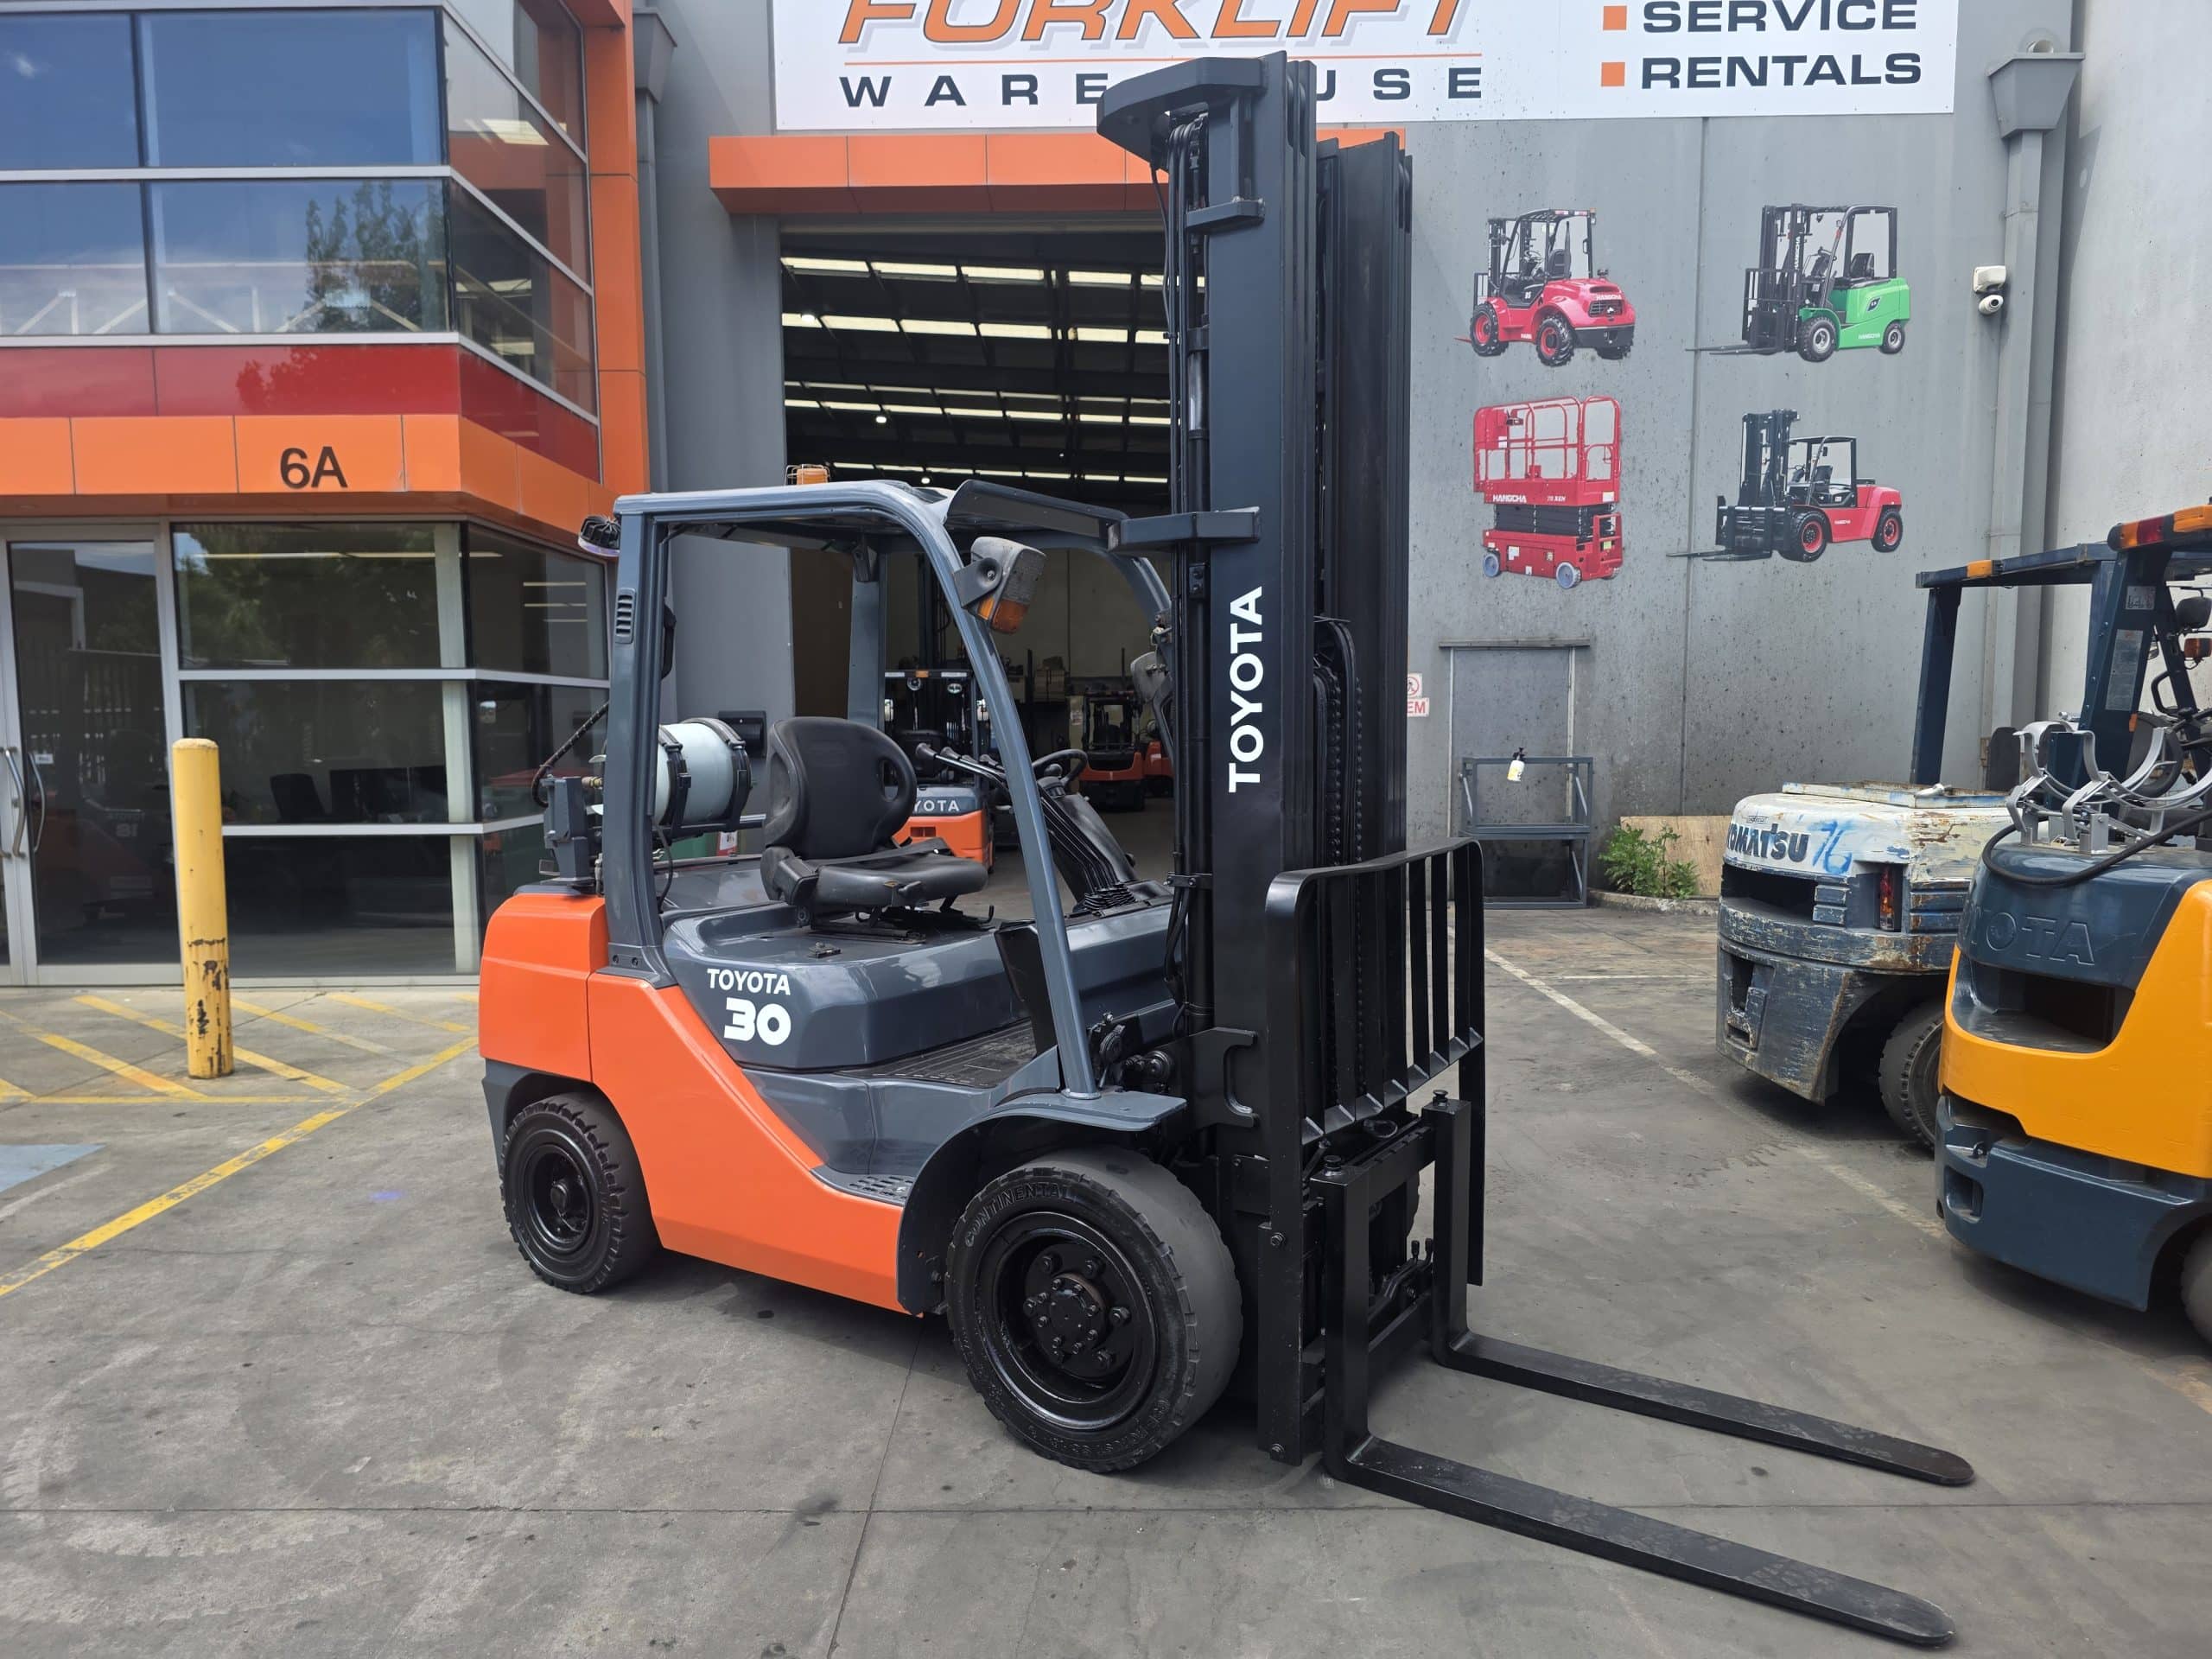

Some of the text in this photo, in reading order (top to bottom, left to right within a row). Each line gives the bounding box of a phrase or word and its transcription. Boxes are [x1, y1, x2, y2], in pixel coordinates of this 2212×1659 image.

[1643, 0, 1917, 33] SERVICE
[839, 67, 1482, 107] WAREUSE
[1642, 53, 1921, 89] RENTALS
[280, 446, 348, 490] 6A
[1492, 494, 1527, 503] HANGCHA
[1229, 586, 1264, 793] TOYOTA
[914, 799, 959, 812] YOTA
[1726, 823, 1810, 862] OMATSU
[707, 968, 791, 995] TOYOTA
[724, 997, 791, 1046] 30
[965, 1181, 1077, 1248] CONTINENTAL
